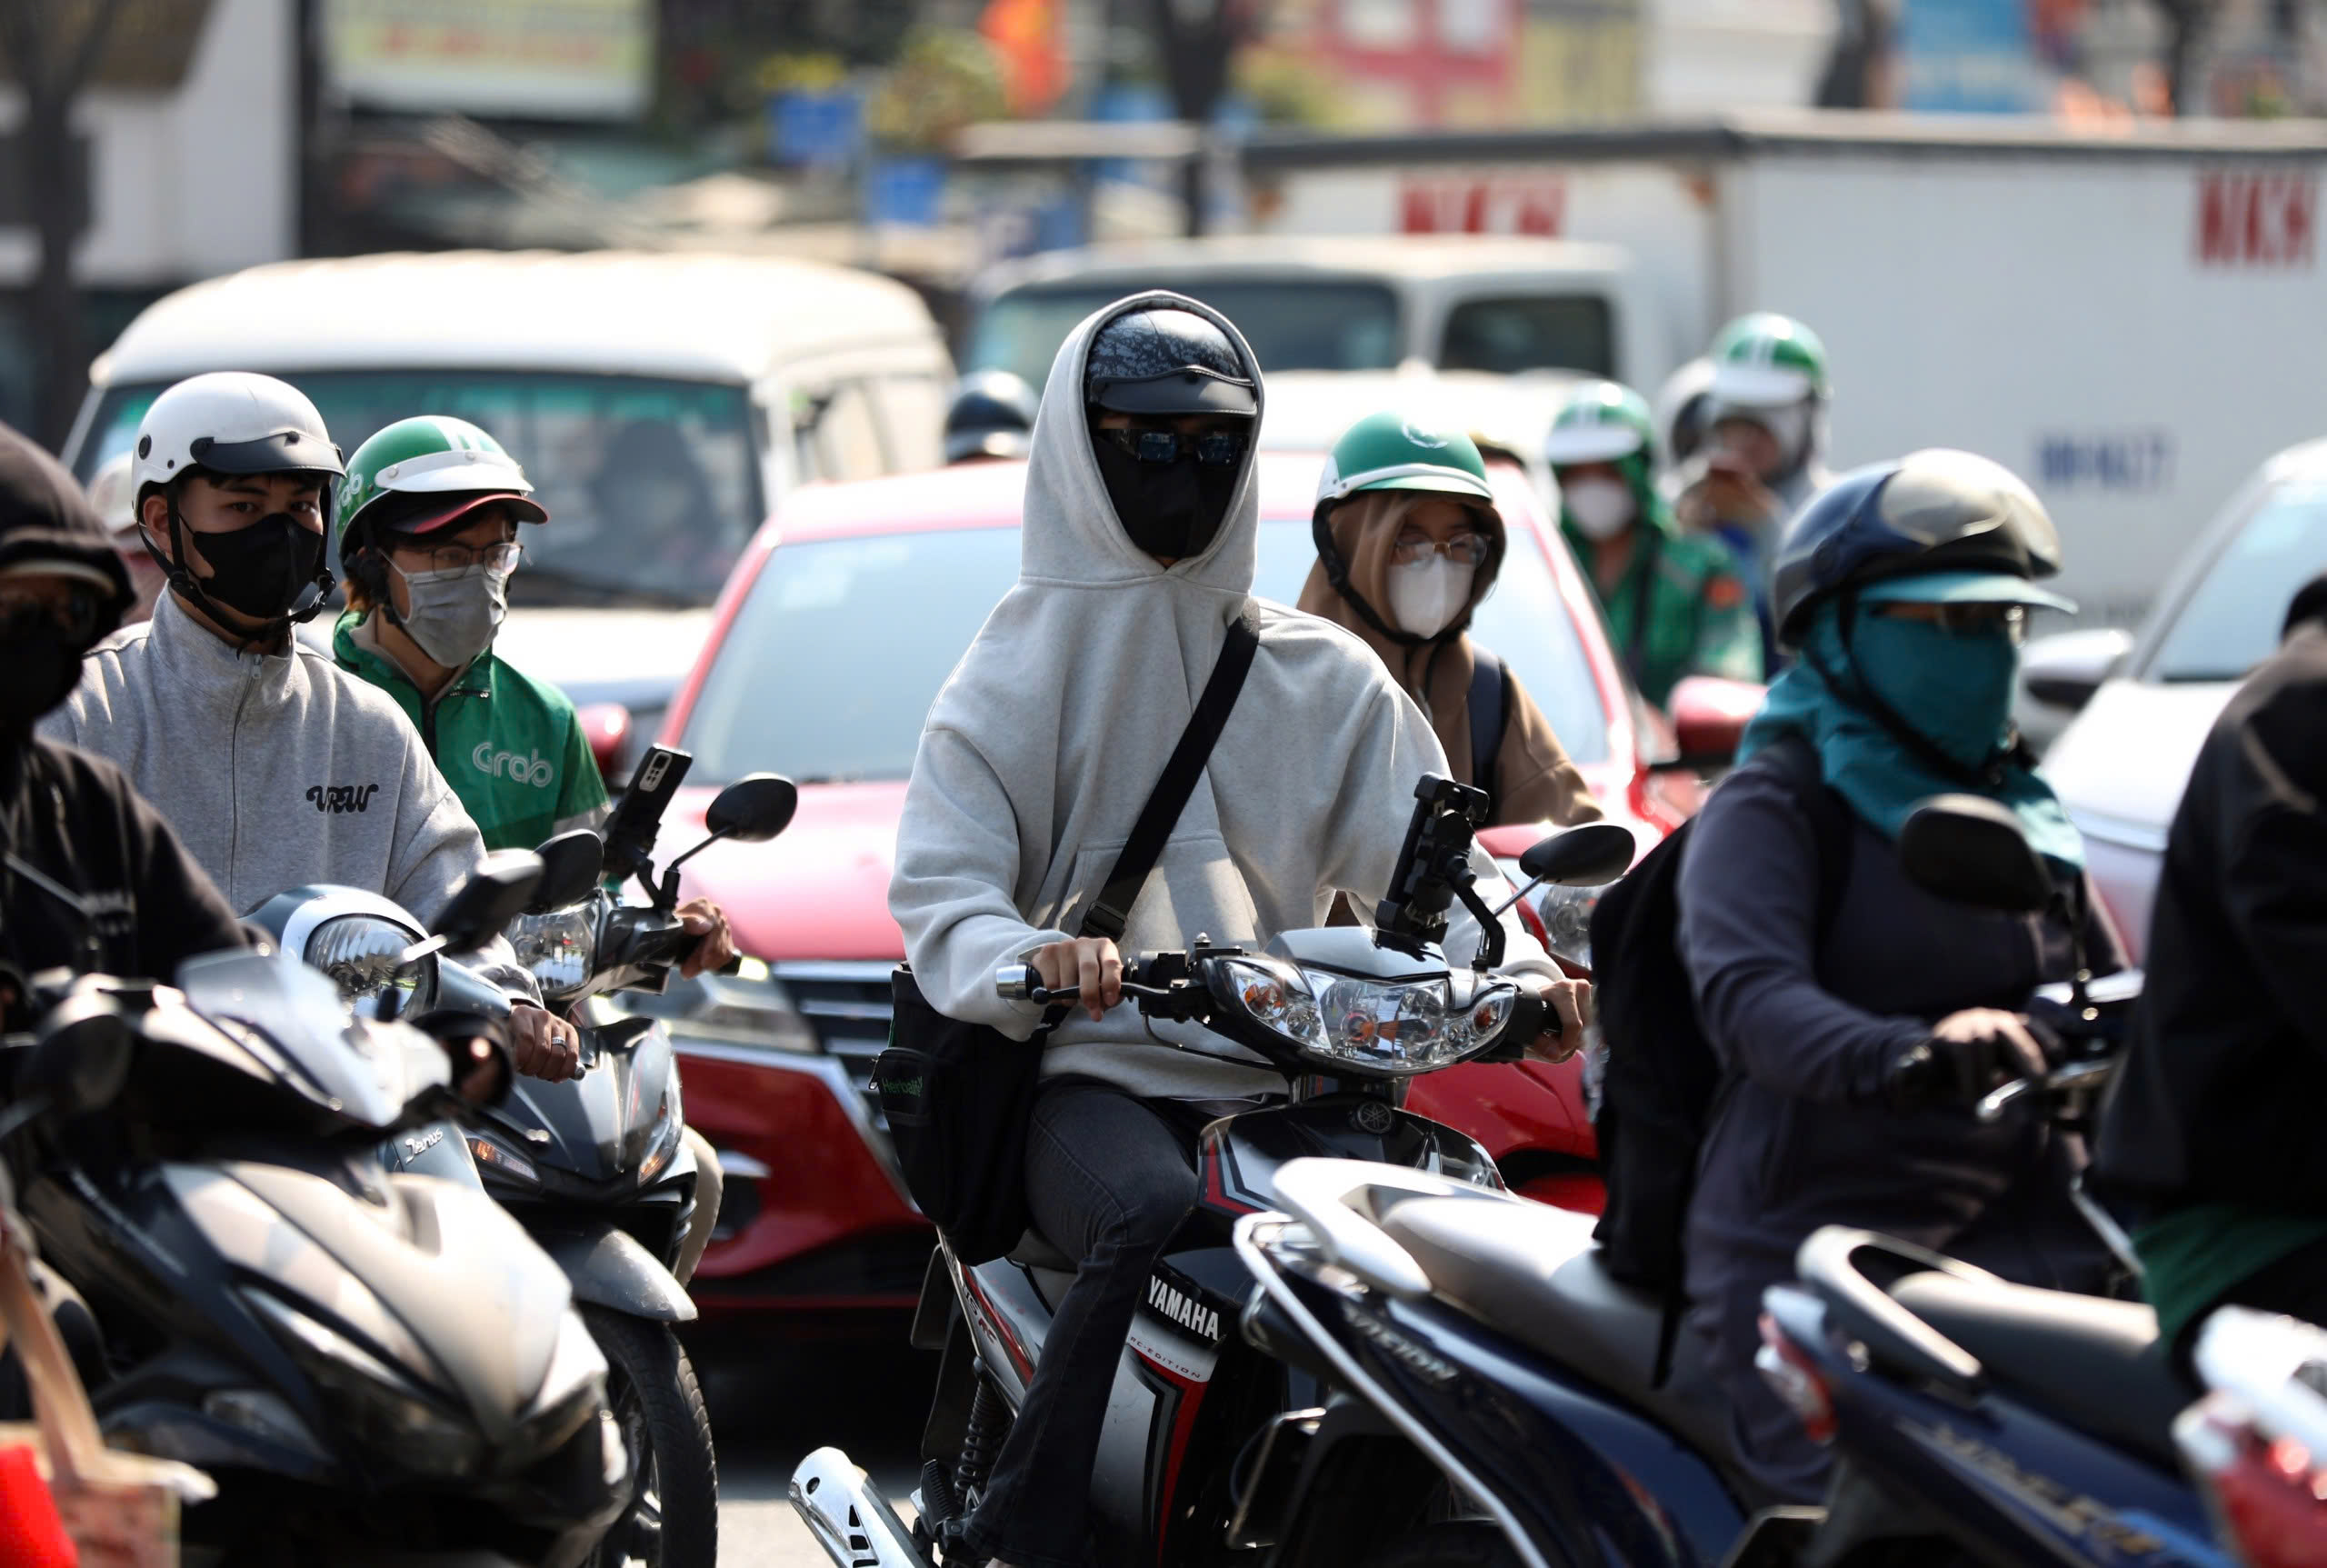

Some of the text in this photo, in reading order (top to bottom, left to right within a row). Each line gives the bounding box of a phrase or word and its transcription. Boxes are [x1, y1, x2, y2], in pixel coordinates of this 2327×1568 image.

[472, 741, 554, 789] Grab
[1148, 1273, 1219, 1342] YAMAHA
[1130, 1336, 1201, 1379] RC-EDITION
